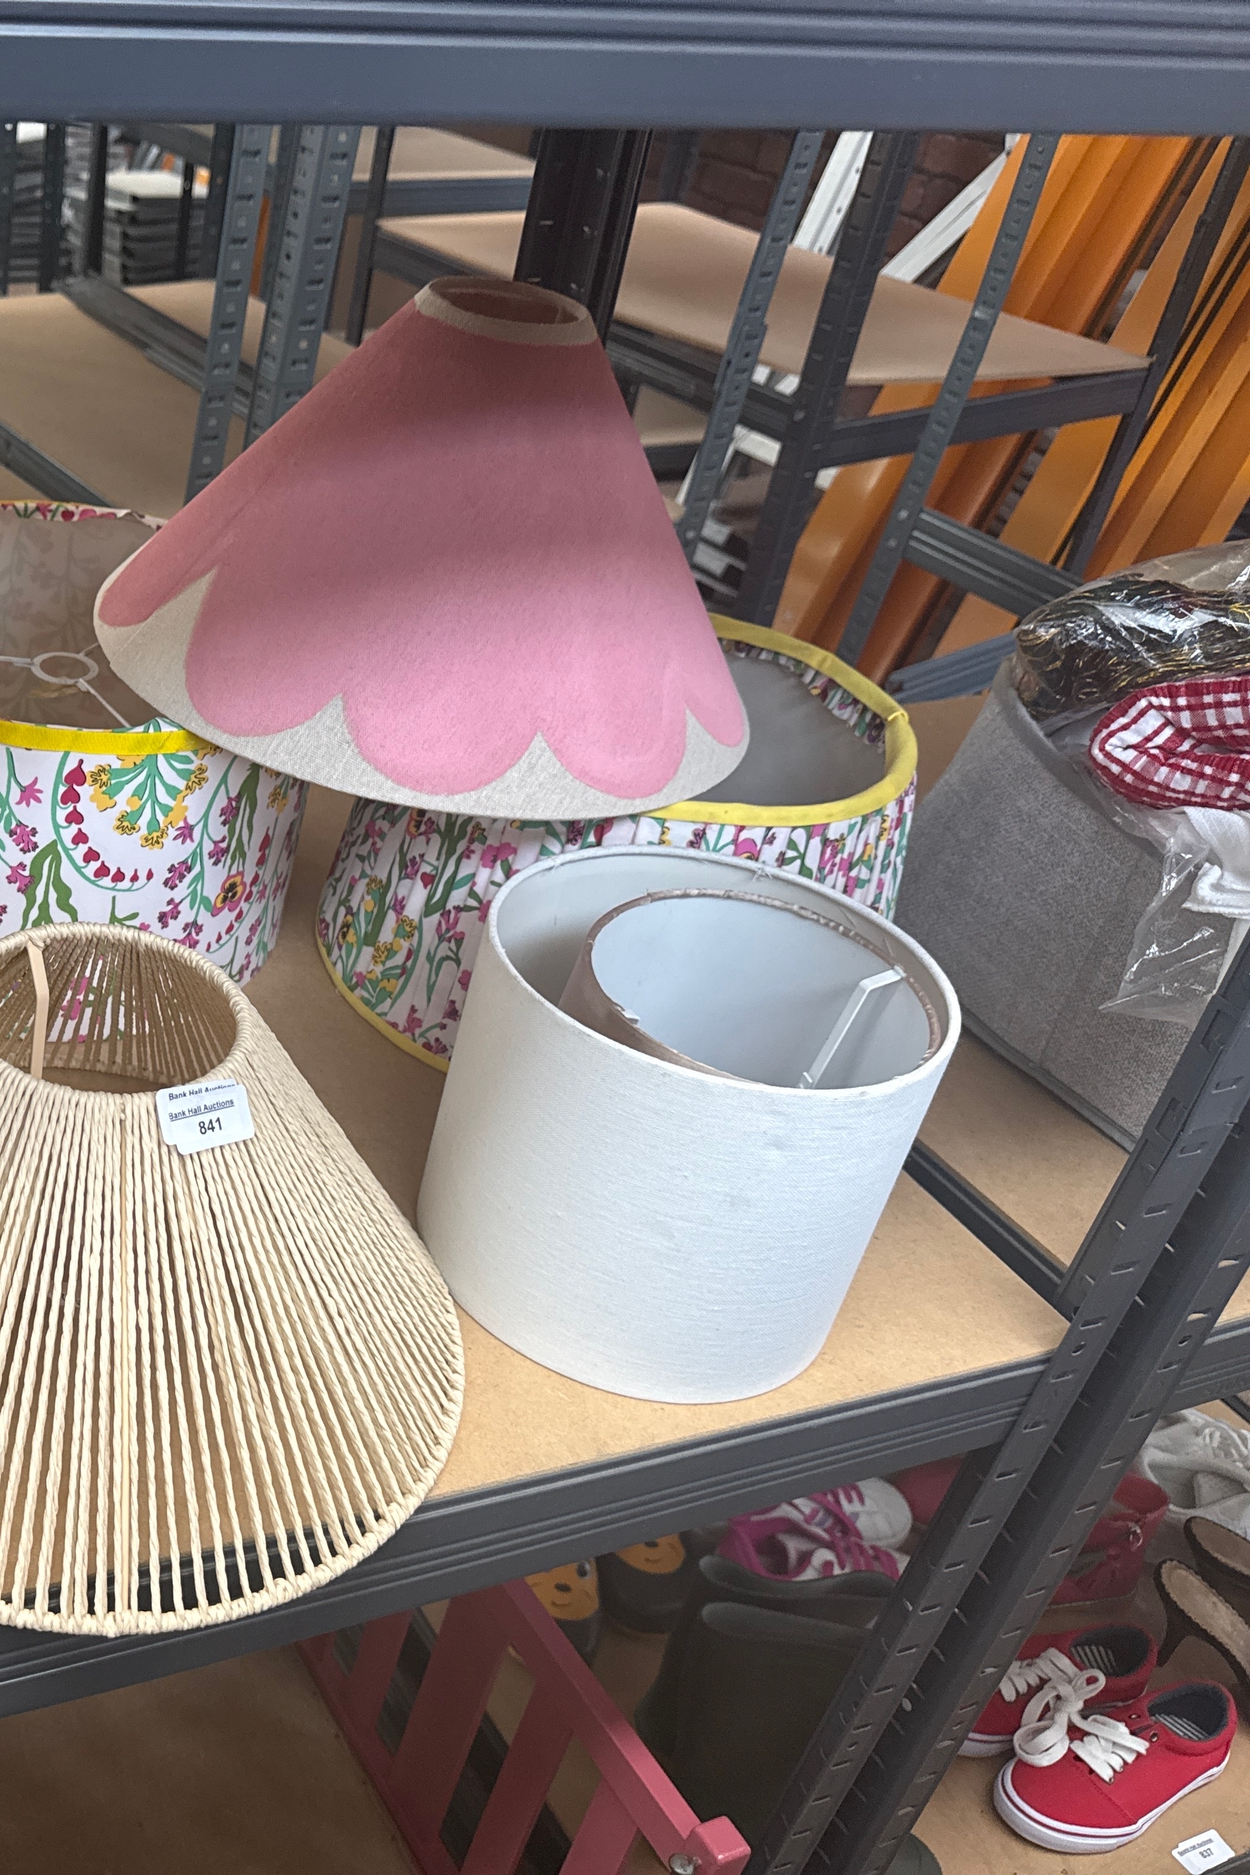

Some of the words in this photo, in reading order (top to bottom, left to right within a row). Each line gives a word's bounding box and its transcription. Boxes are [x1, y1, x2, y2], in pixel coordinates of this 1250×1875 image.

[168, 1092, 187, 1100] Bank
[189, 1088, 202, 1096] Hall
[168, 1110, 186, 1120] Bank
[188, 1106, 202, 1115] Hall
[203, 1099, 234, 1111] Auctions
[198, 1117, 222, 1135] 841
